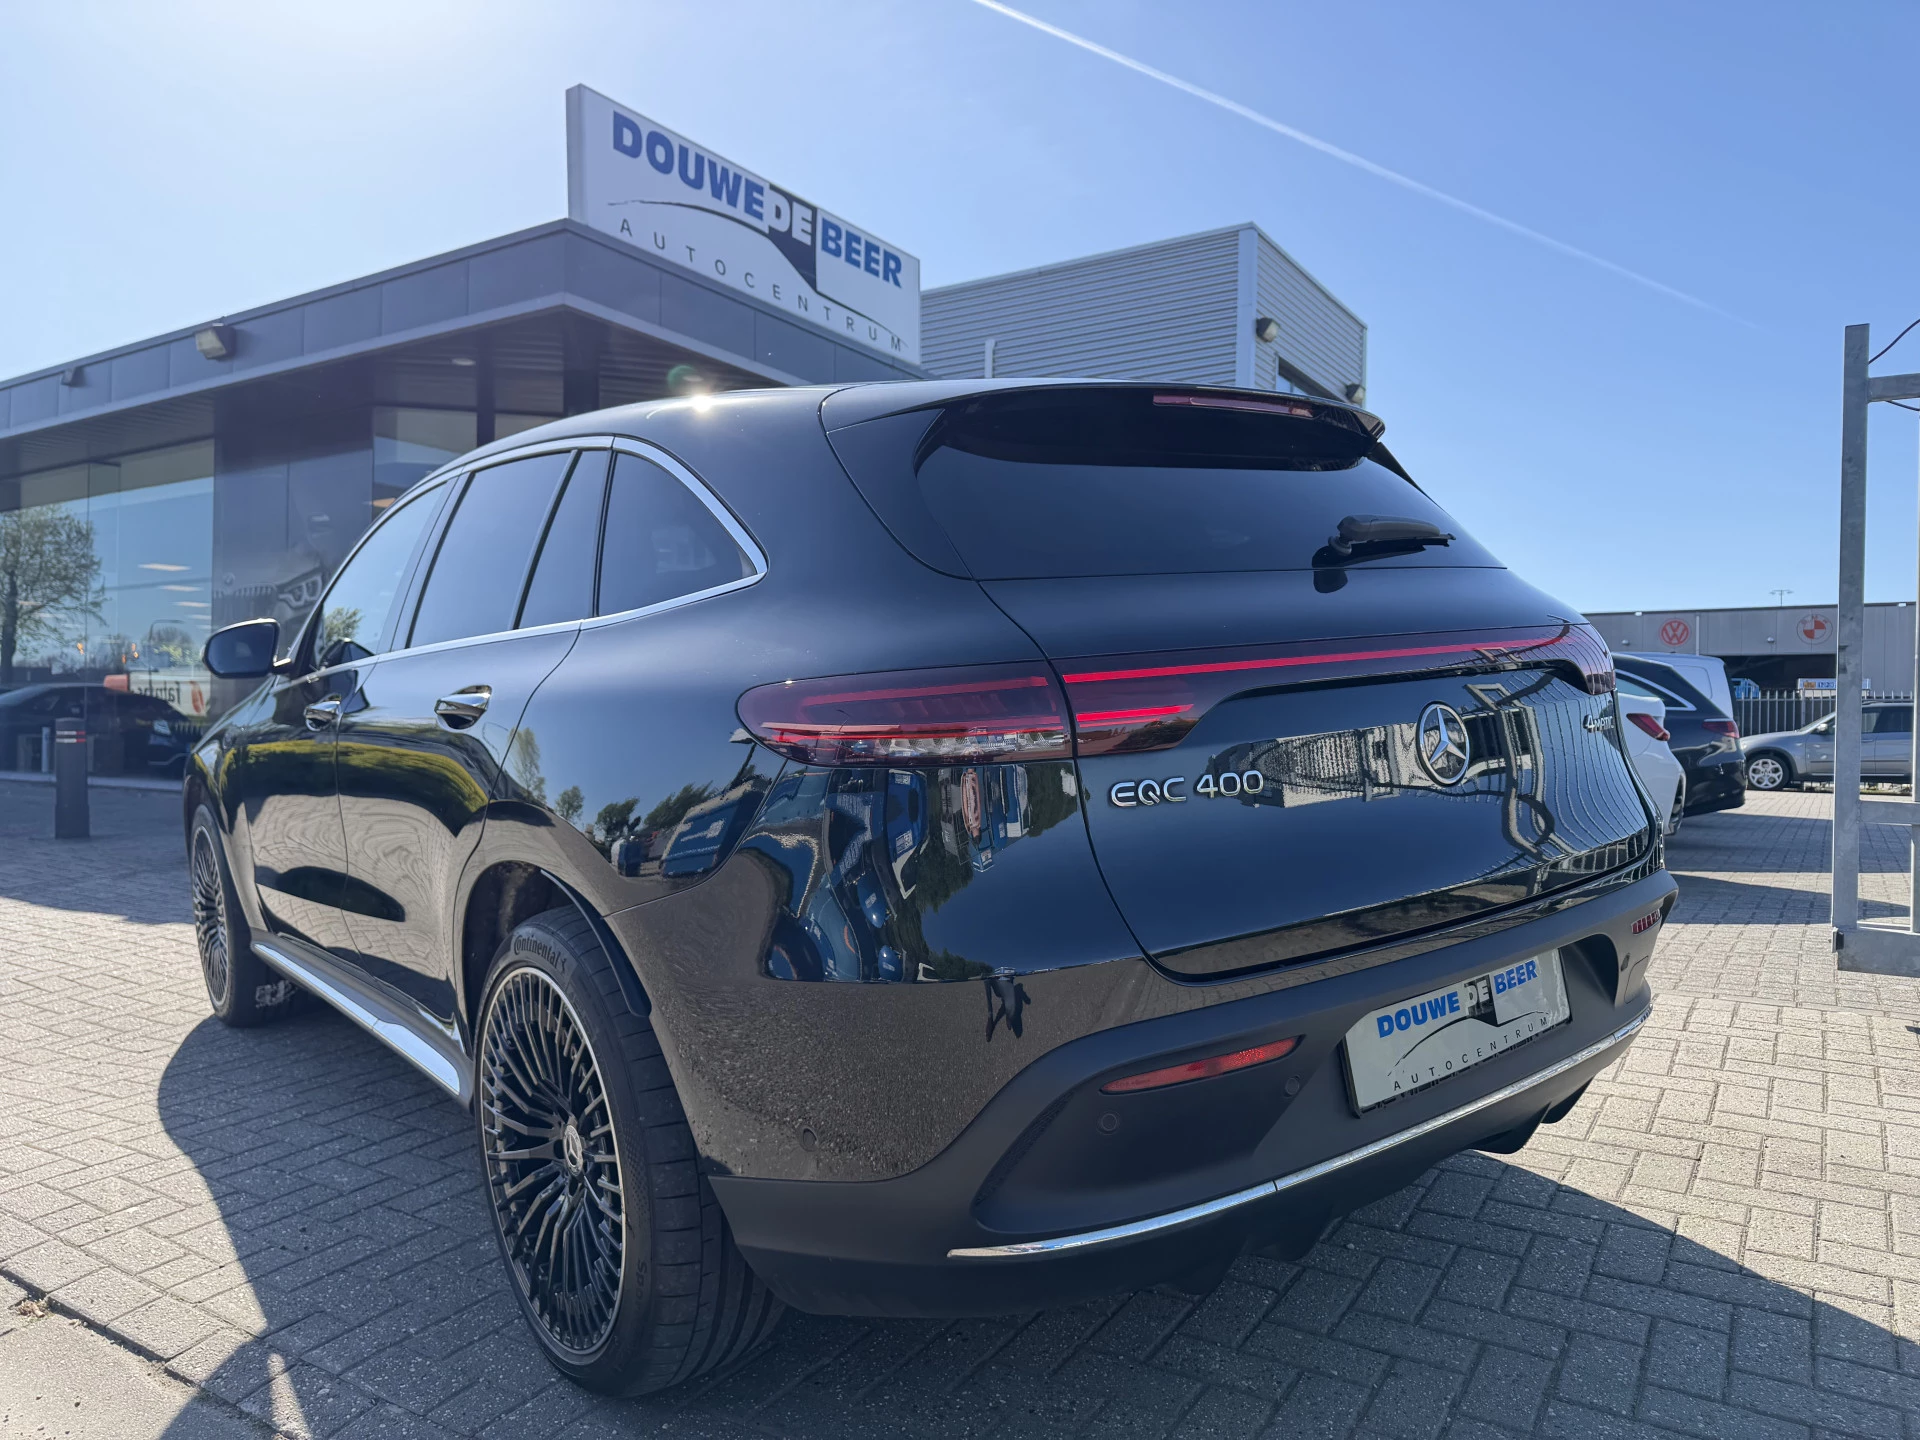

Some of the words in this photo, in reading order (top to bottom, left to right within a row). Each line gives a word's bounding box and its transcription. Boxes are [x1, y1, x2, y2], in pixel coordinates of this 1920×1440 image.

[612, 109, 764, 222] DOUWE
[768, 190, 813, 247] DE
[821, 216, 903, 289] BEER
[619, 217, 902, 352] AUTOCENTRUM
[1110, 776, 1187, 809] EQC
[1195, 769, 1264, 799] 400
[513, 933, 562, 968] Continental
[1376, 990, 1461, 1039] DOUWE
[1464, 980, 1491, 1009] DE
[1493, 959, 1539, 995] BEER
[1393, 1017, 1549, 1092] AUTOCENTRUM
